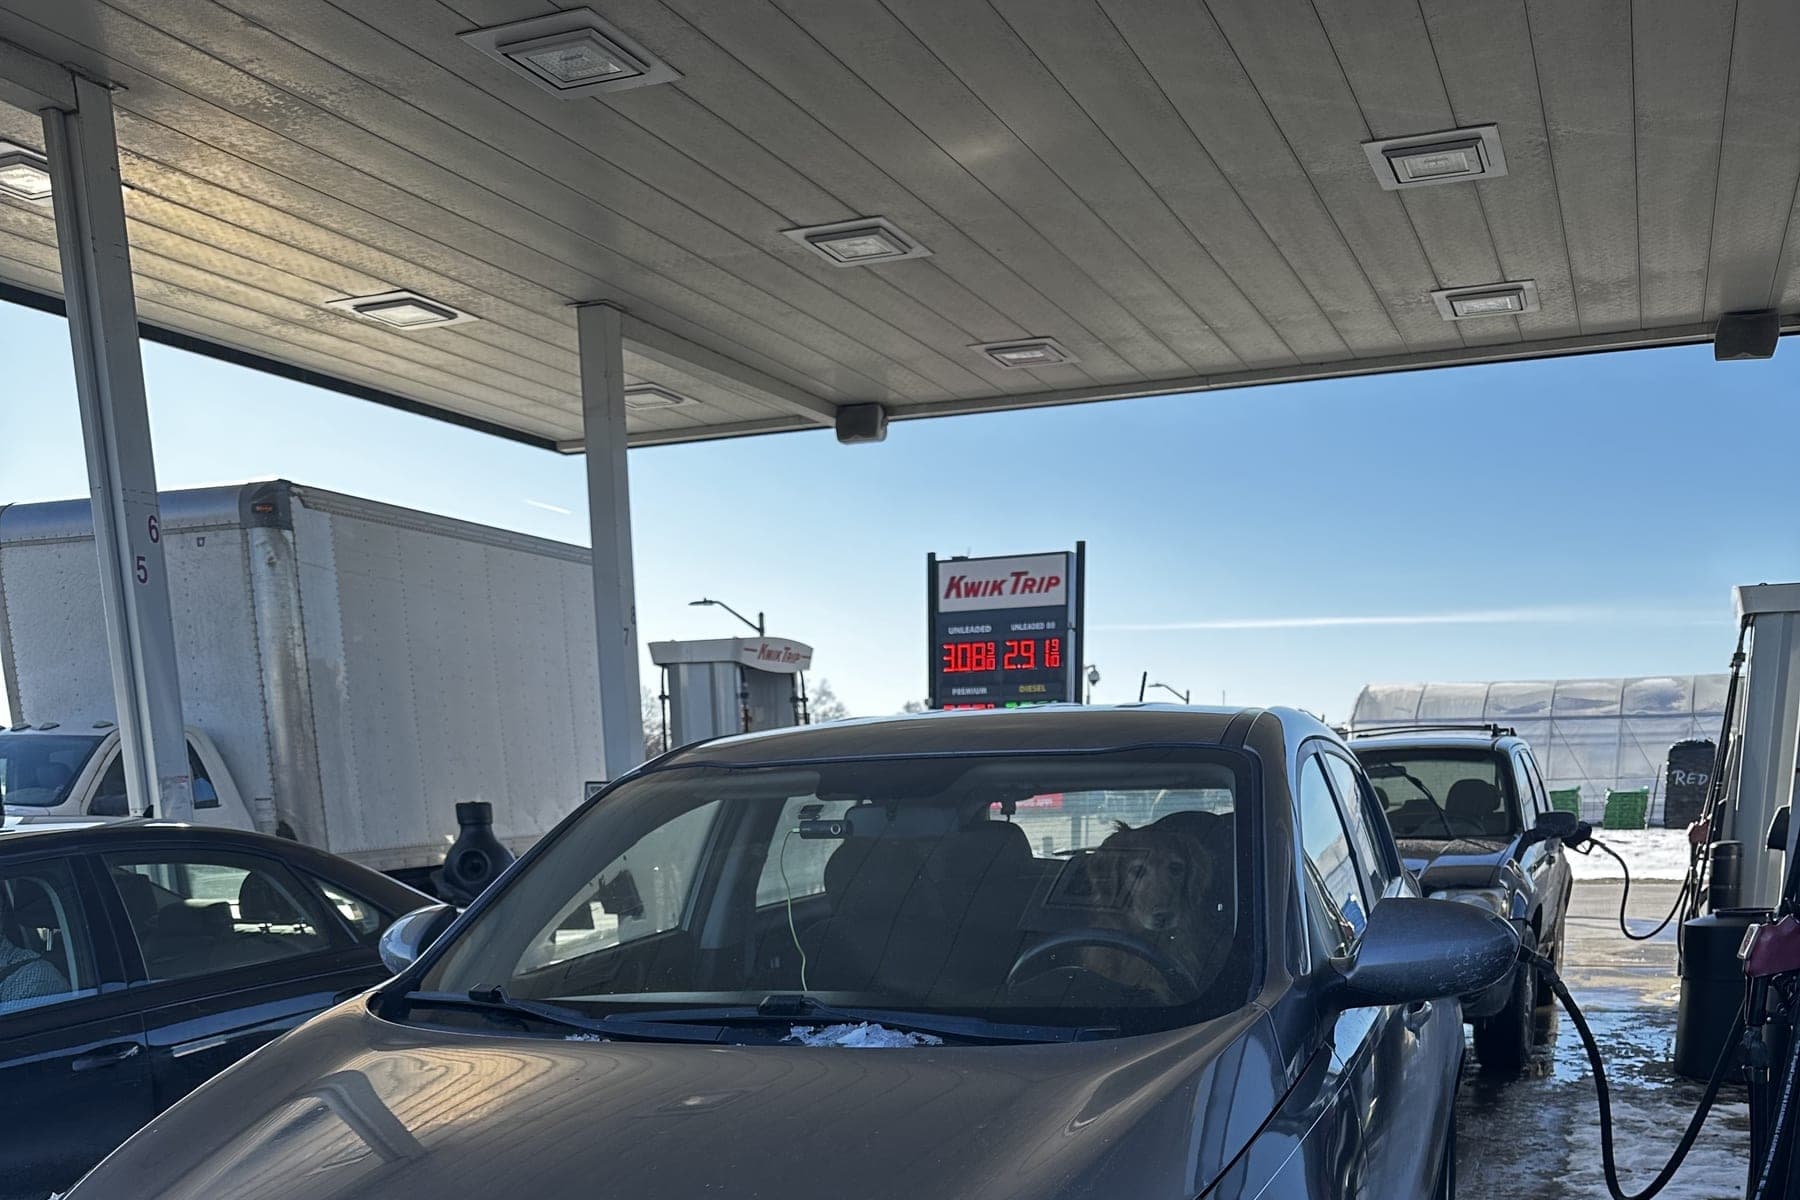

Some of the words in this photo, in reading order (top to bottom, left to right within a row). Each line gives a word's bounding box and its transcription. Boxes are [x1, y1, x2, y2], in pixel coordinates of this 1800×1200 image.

[148, 515, 160, 543] 6
[136, 556, 148, 583] 5
[944, 574, 1007, 600] KWIK
[1010, 571, 1061, 595] TRIP
[948, 624, 993, 635] UNLEADED
[1011, 622, 1045, 631] UNLEADED
[623, 627, 630, 646] 7
[952, 687, 987, 696] PREMIUM
[1019, 684, 1047, 693] DIESEL
[1671, 769, 1709, 786] RED
